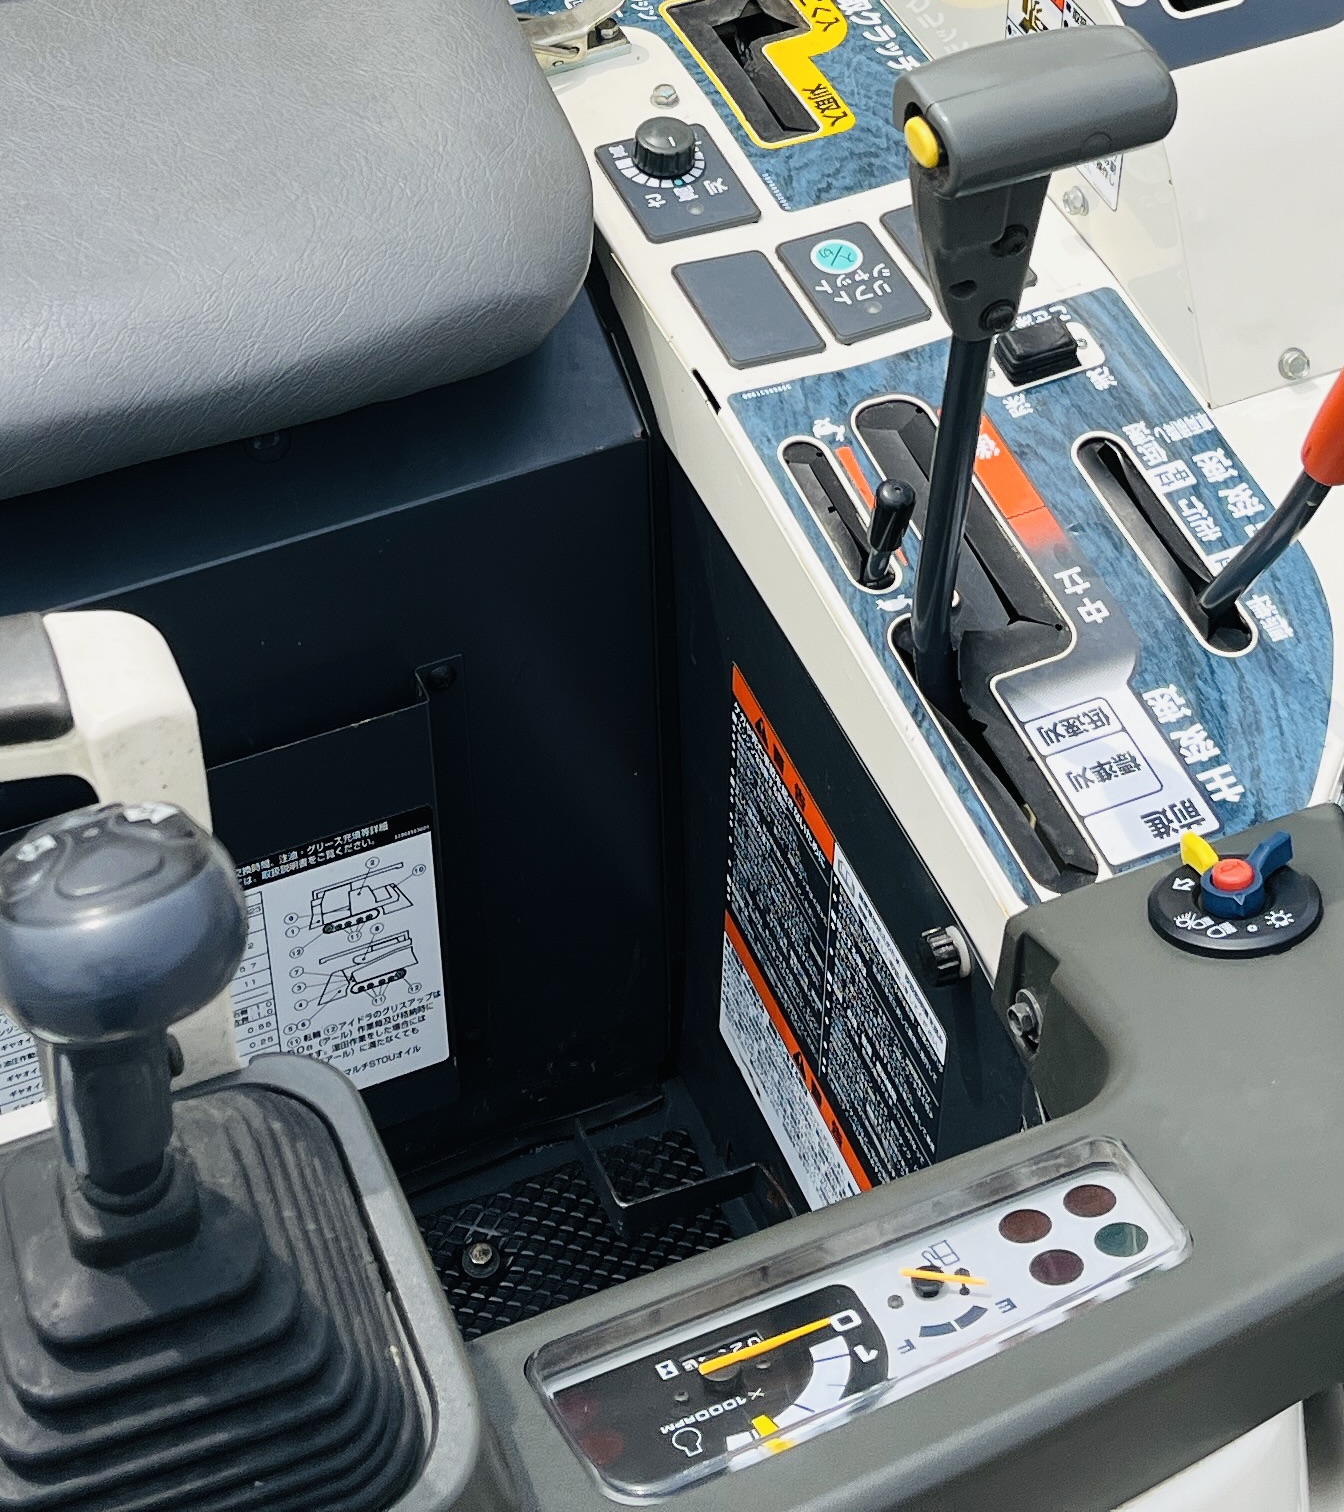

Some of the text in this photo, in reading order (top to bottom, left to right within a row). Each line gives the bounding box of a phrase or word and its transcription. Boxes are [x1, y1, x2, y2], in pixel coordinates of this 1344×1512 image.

[802, 83, 848, 127] 刈取入
[815, 262, 891, 295] シャット
[834, 280, 892, 305] リフト
[1122, 420, 1168, 466] 低速
[1192, 448, 1266, 538] 変速
[1178, 495, 1223, 541] 走行
[1053, 566, 1110, 625] 中立
[1245, 593, 1294, 643] 標準
[1036, 706, 1112, 747] 低速刈
[1142, 684, 1245, 803] 主変速
[1065, 750, 1142, 793] 標準刈
[1140, 798, 1206, 839] 前進
[897, 1338, 916, 1355] F
